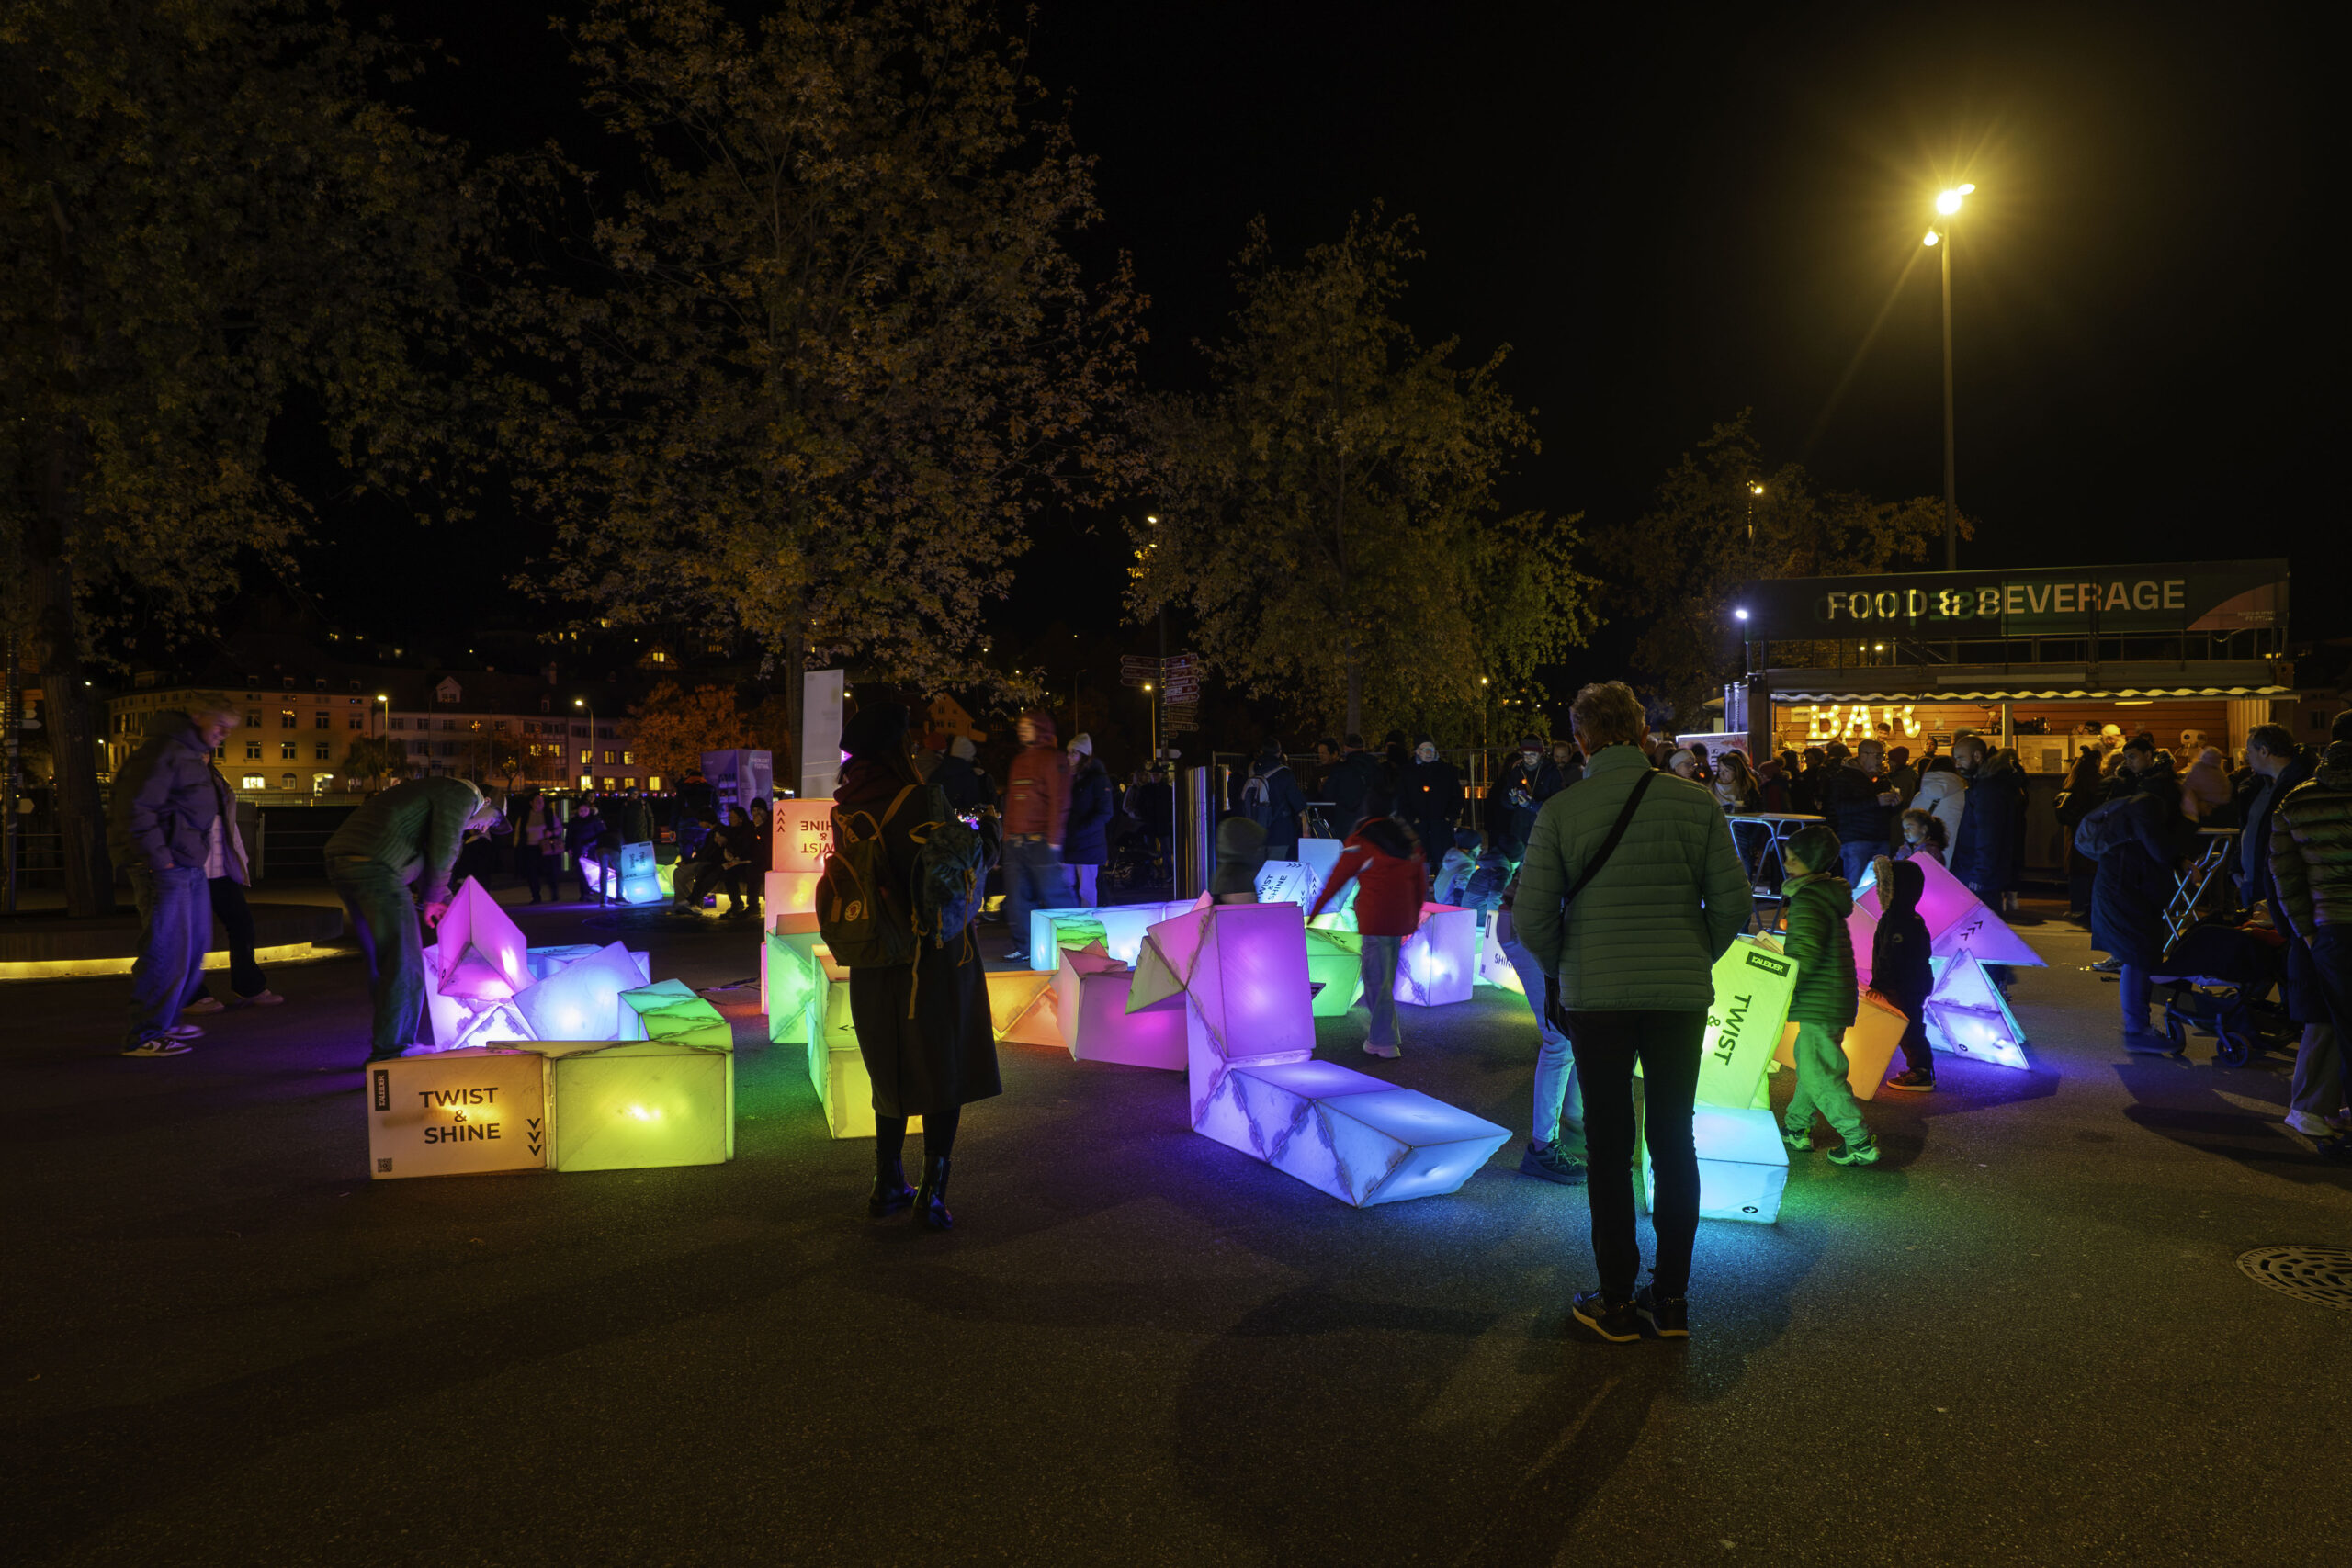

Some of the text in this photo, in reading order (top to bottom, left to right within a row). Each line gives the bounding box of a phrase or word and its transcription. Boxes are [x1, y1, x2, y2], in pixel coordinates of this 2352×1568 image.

[1827, 580, 2186, 620] FOOD & BEVERAGE
[1805, 705, 1921, 739] BAR
[820, 832, 827, 841] &
[800, 842, 835, 853] WIST
[1267, 875, 1288, 900] SHINE
[1494, 953, 1514, 969] SHIN
[1707, 1015, 1721, 1027] &
[1714, 995, 1752, 1066] TWIST
[418, 1087, 499, 1108] TWIST
[454, 1109, 467, 1122] &
[424, 1122, 502, 1145] SHINE
